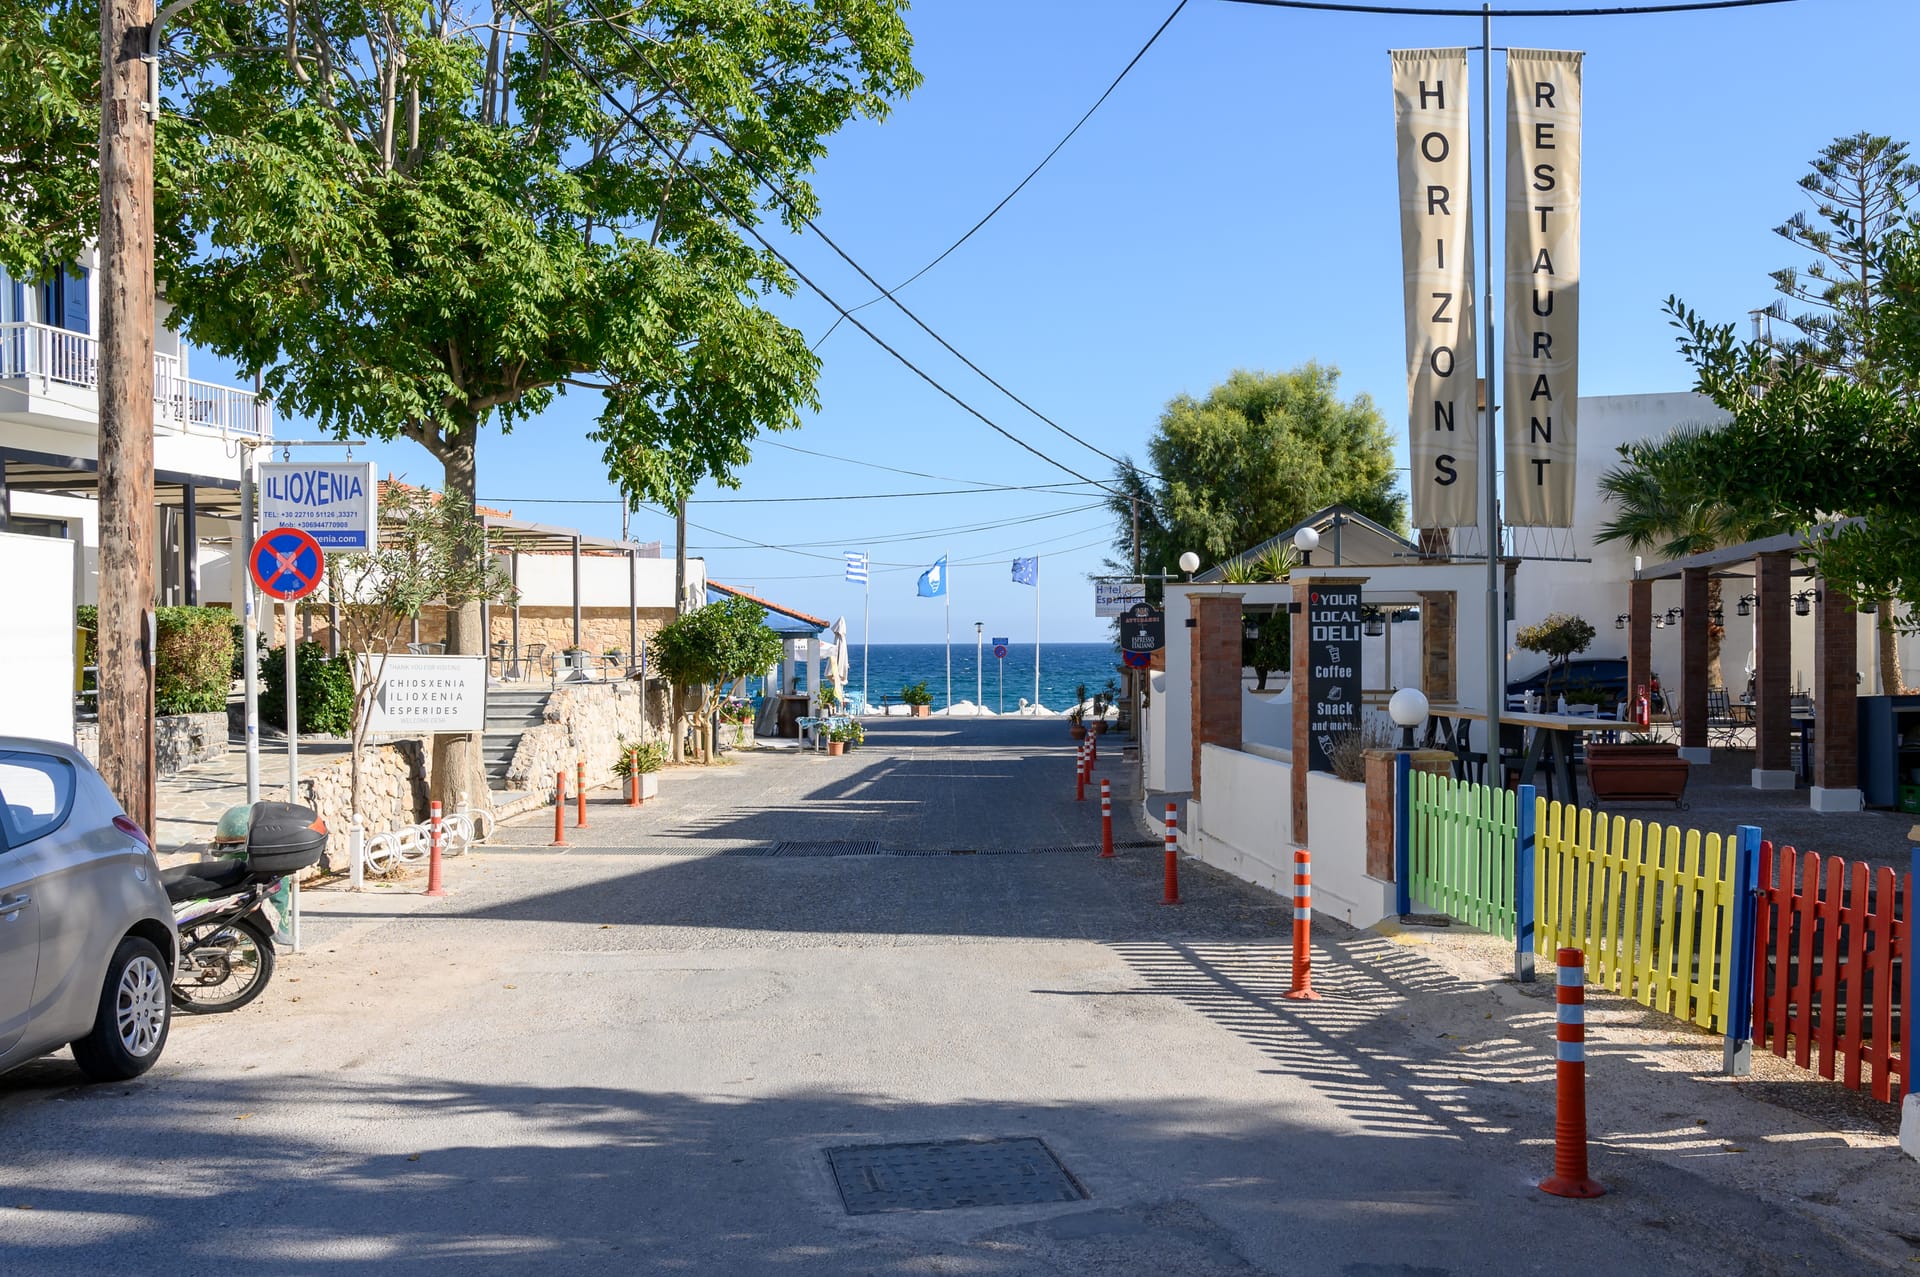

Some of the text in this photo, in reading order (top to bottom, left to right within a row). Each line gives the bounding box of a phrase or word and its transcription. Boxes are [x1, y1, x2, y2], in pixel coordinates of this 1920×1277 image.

[1418, 79, 1458, 487] HORIZONS
[1529, 81, 1556, 486] RESTAURANT
[267, 470, 363, 507] ILIOXENIA
[1096, 585, 1122, 594] Htel
[1320, 594, 1358, 606] YOUR
[1311, 611, 1361, 623] LOCAL
[1312, 625, 1360, 642] DELI
[1315, 665, 1352, 678] Coffee
[389, 679, 465, 688] CHIOSXENIA
[390, 692, 463, 701] ILIOXENIA
[389, 706, 459, 715] ESPERIDES
[1317, 702, 1353, 716] Snack
[1311, 720, 1328, 731] and
